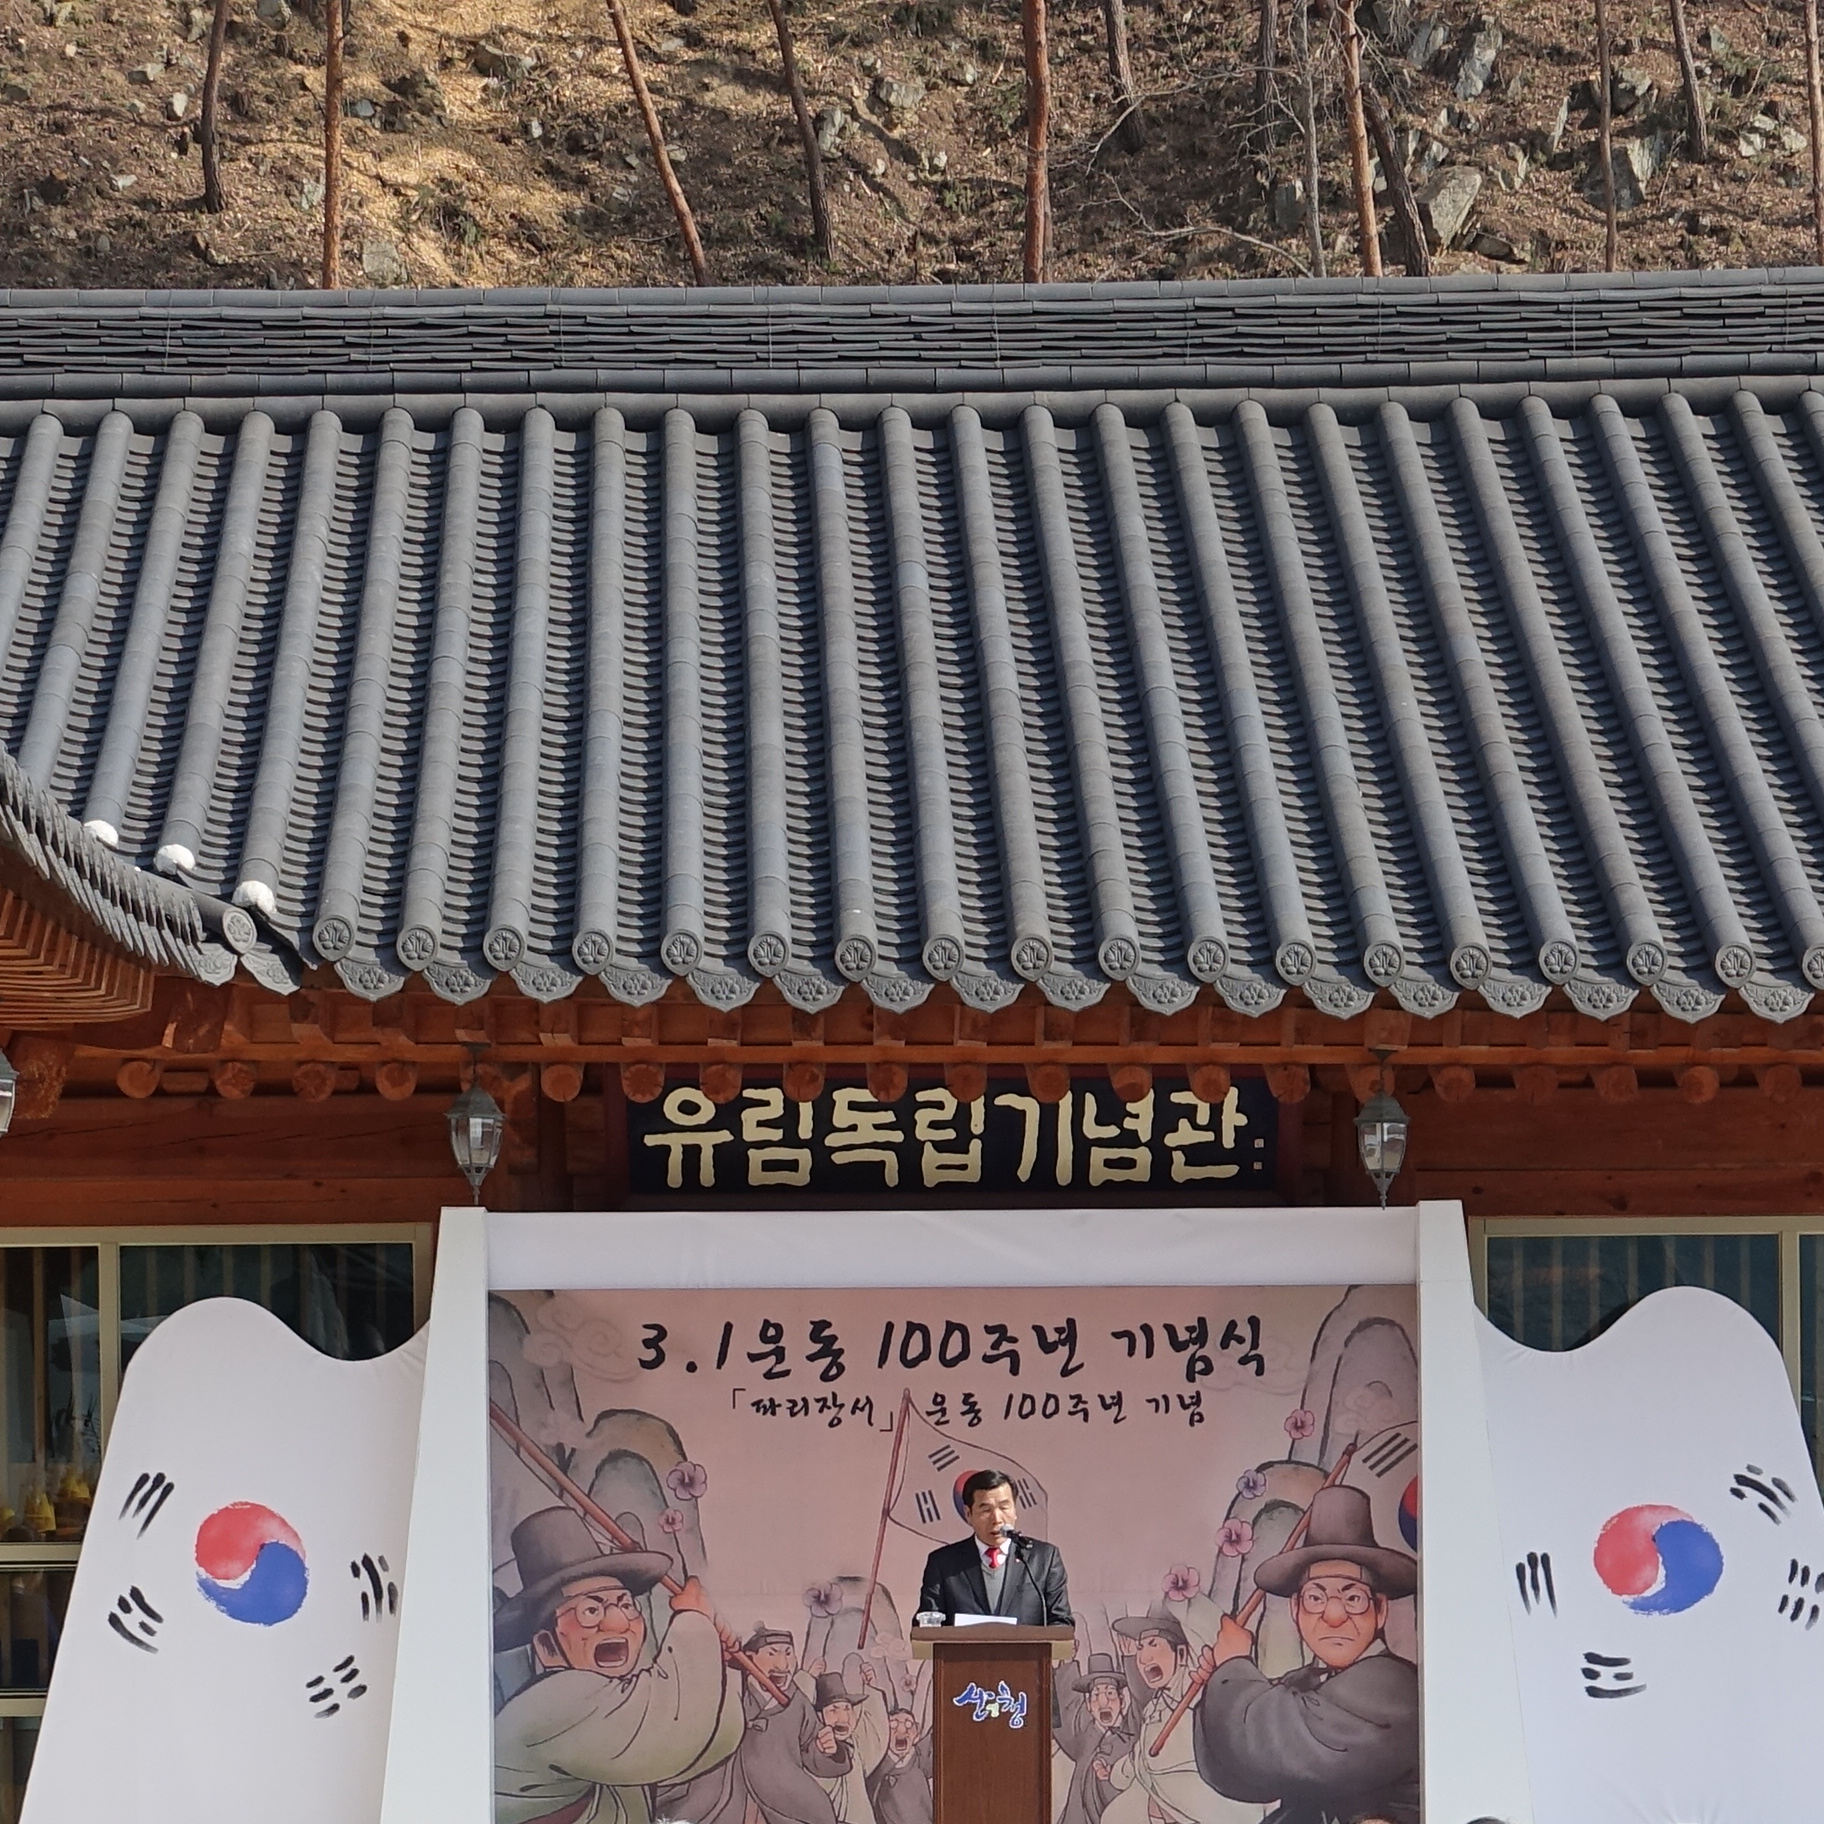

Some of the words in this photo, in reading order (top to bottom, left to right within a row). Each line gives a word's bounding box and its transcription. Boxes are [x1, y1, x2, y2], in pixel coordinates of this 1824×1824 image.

[643, 1086, 1248, 1188] 유림독립기념관
[638, 1318, 845, 1382] 3.1운동
[878, 1317, 1084, 1377] 100주년
[1111, 1315, 1265, 1383] 기념식
[925, 1391, 983, 1427] 운동
[1003, 1390, 1127, 1425] 100주년
[1144, 1390, 1205, 1427] 기념
